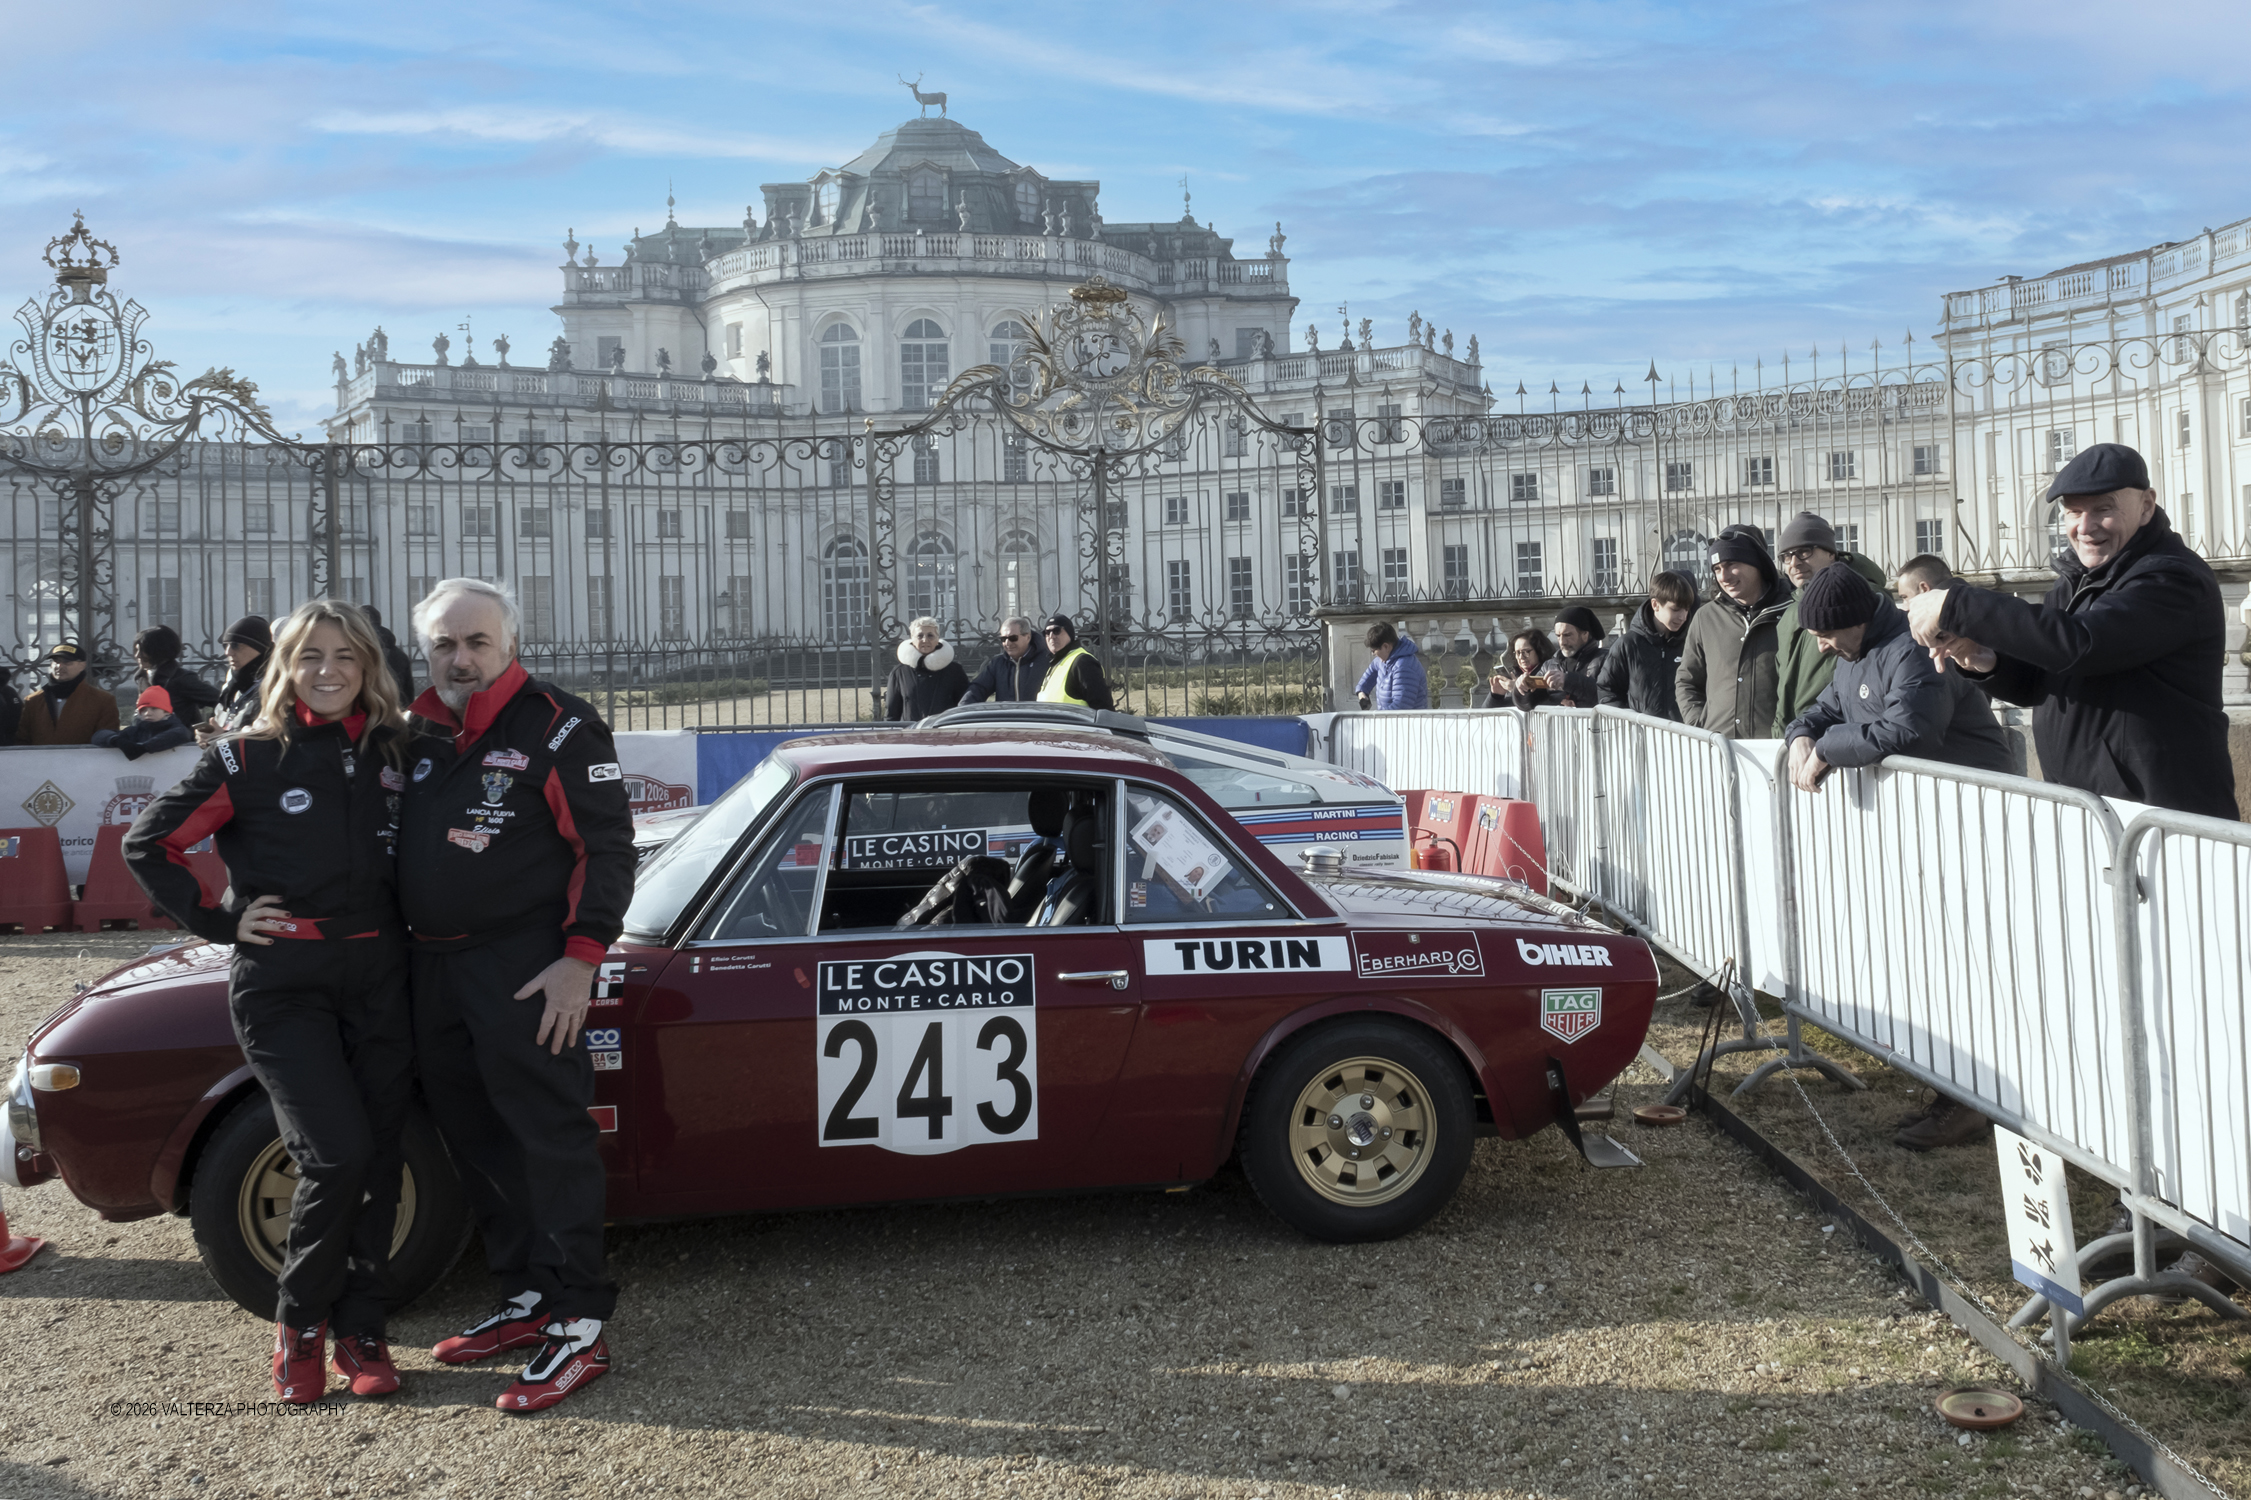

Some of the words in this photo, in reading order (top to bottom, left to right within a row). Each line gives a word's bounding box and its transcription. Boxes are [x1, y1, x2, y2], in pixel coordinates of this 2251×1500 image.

[548, 716, 580, 751] sparco
[647, 783, 669, 801] 2026
[466, 808, 491, 816] LANCIA
[487, 816, 504, 824] 1600
[1313, 809, 1356, 820] MARTINI
[60, 836, 94, 846] torico
[853, 839, 877, 857] LE
[883, 832, 982, 855] CASINO
[1315, 830, 1359, 841] RACING
[860, 858, 914, 869] MONTE
[925, 854, 970, 867] CARL
[1174, 939, 1322, 971] TURIN
[1360, 951, 1454, 972] EBERHARD
[827, 964, 864, 991] LE
[873, 959, 1025, 989] CASINO
[595, 998, 620, 1006] CORSE
[838, 995, 921, 1012] MONTE
[938, 991, 1014, 1007] CARLO
[1549, 995, 1594, 1010] TAG
[1547, 1012, 1595, 1036] HEUER
[823, 1015, 1033, 1141] 243
[555, 1360, 582, 1389] sparco
